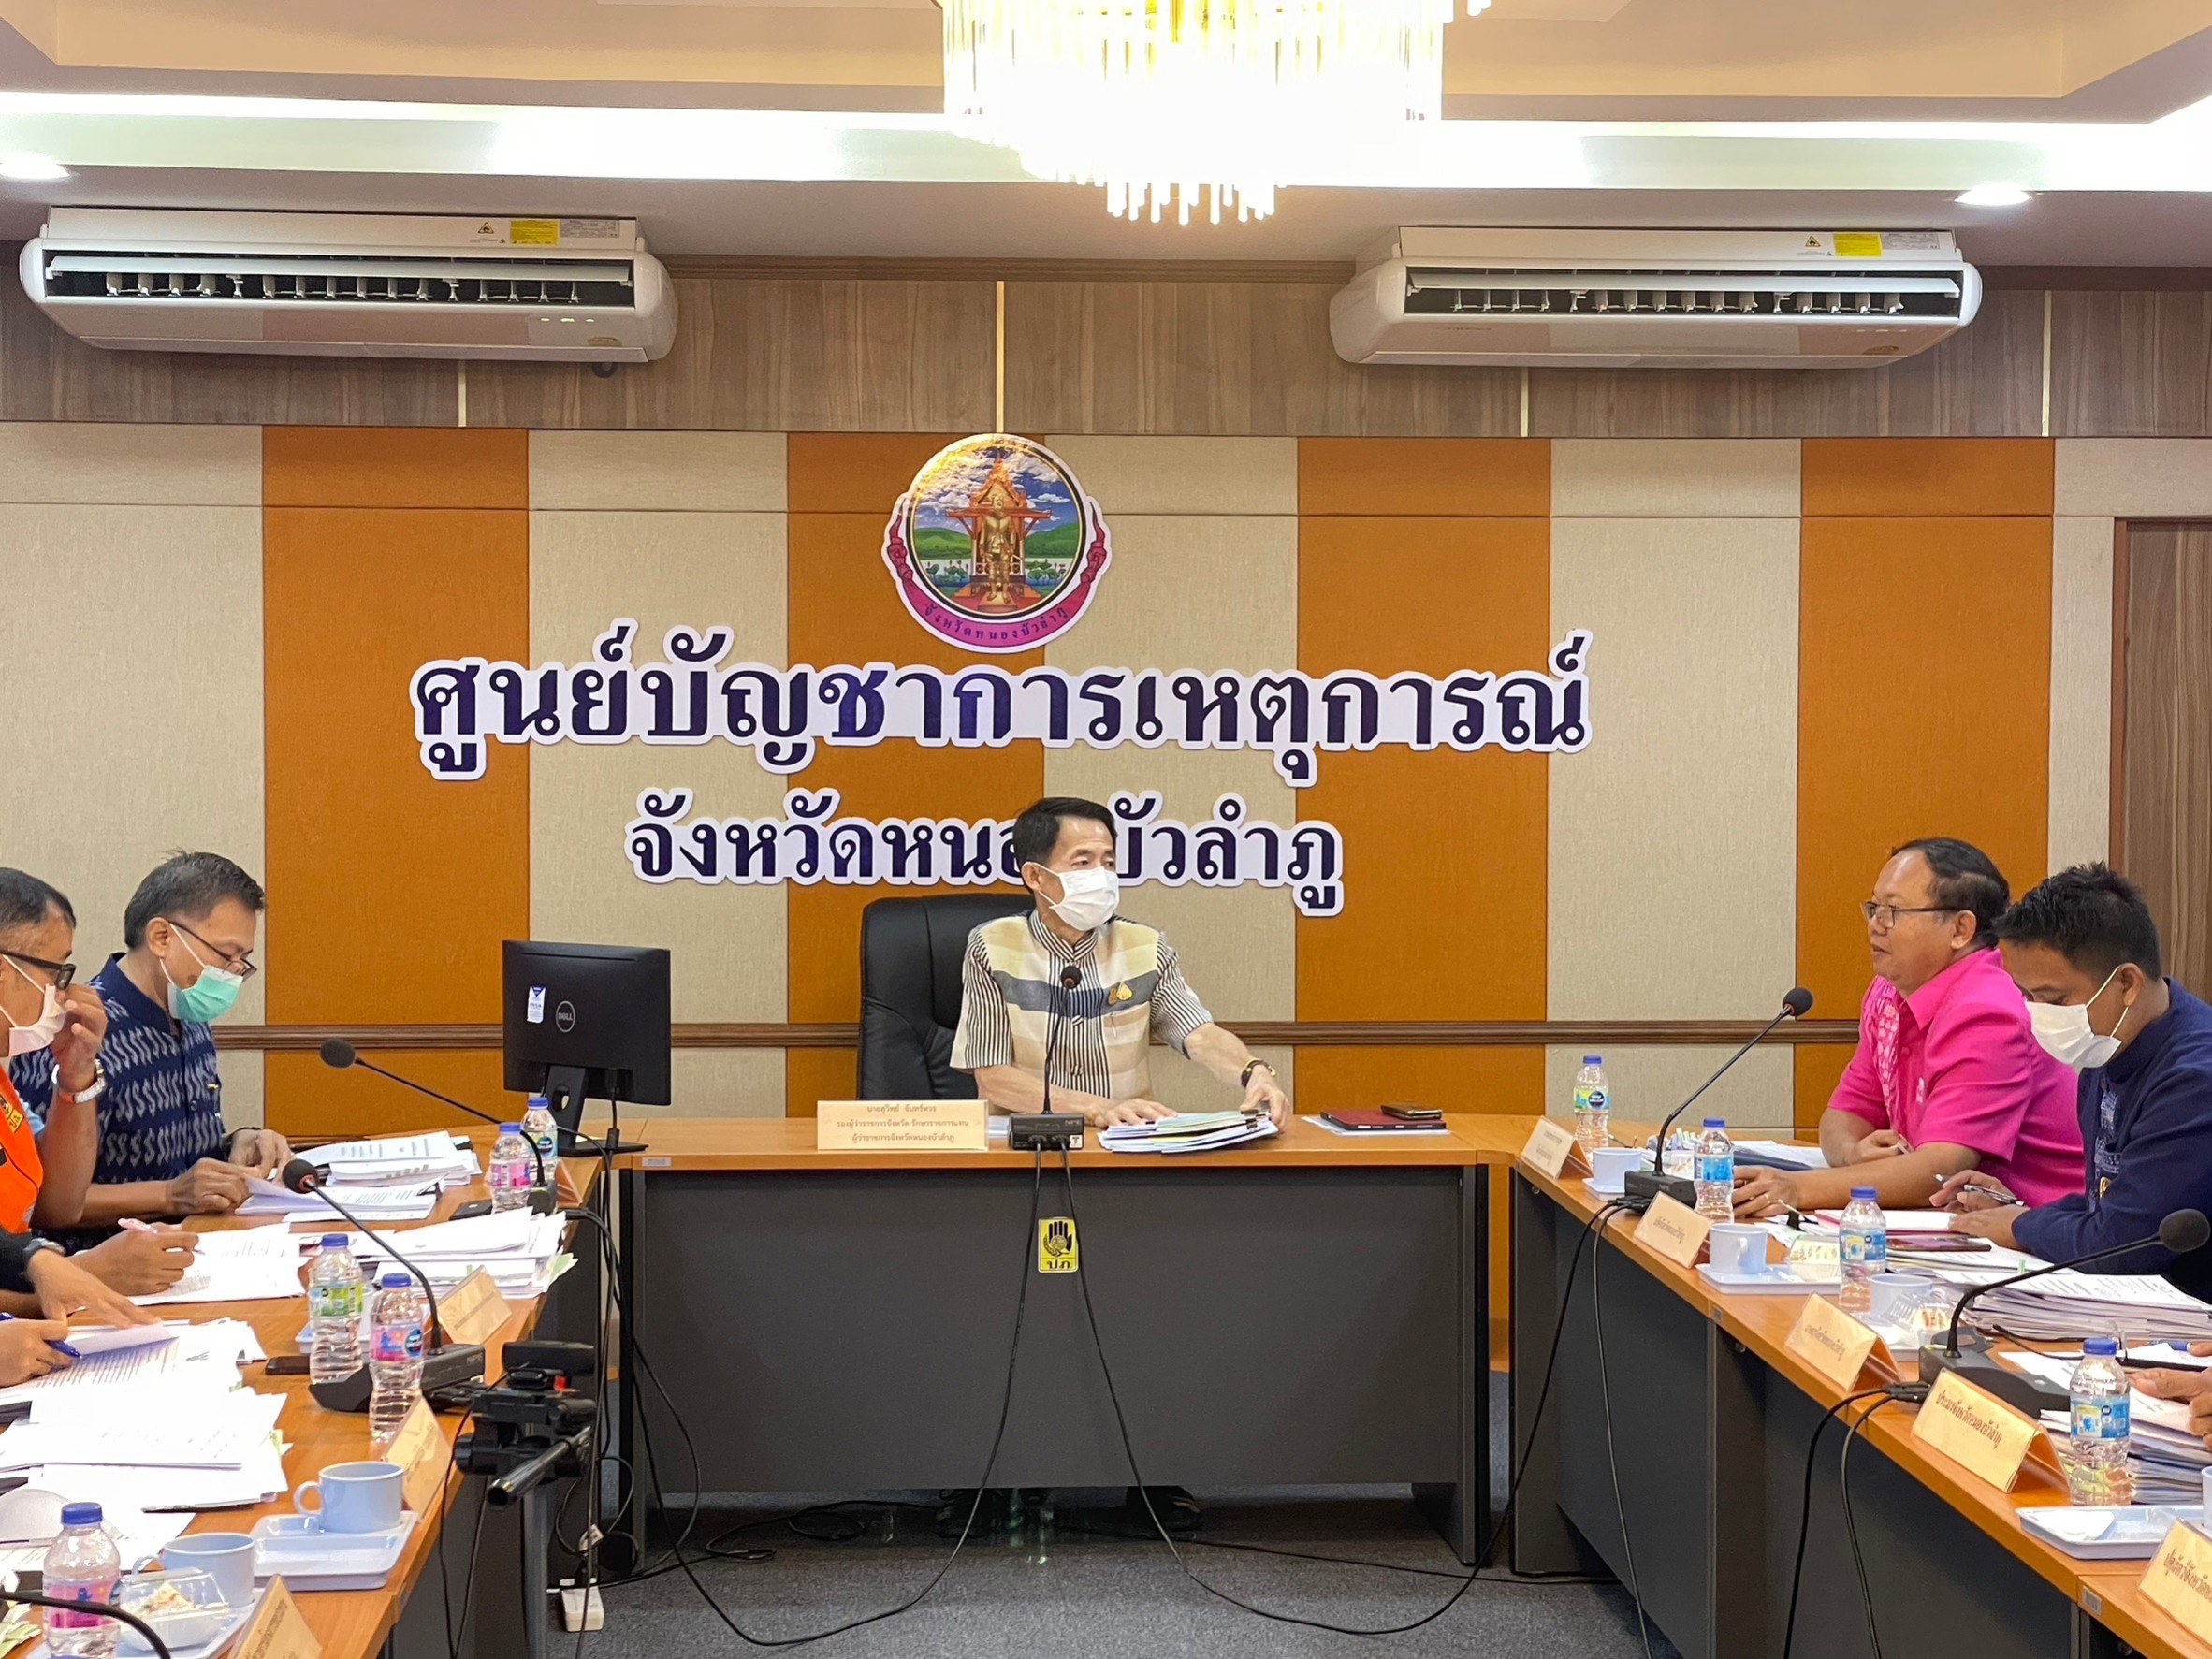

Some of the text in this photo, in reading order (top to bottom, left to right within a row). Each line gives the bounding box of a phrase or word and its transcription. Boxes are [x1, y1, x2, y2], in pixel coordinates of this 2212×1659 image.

[417, 625, 1585, 781] ศูนย์บัญชาการเหตุการณ์
[558, 1012, 574, 1022] DELL
